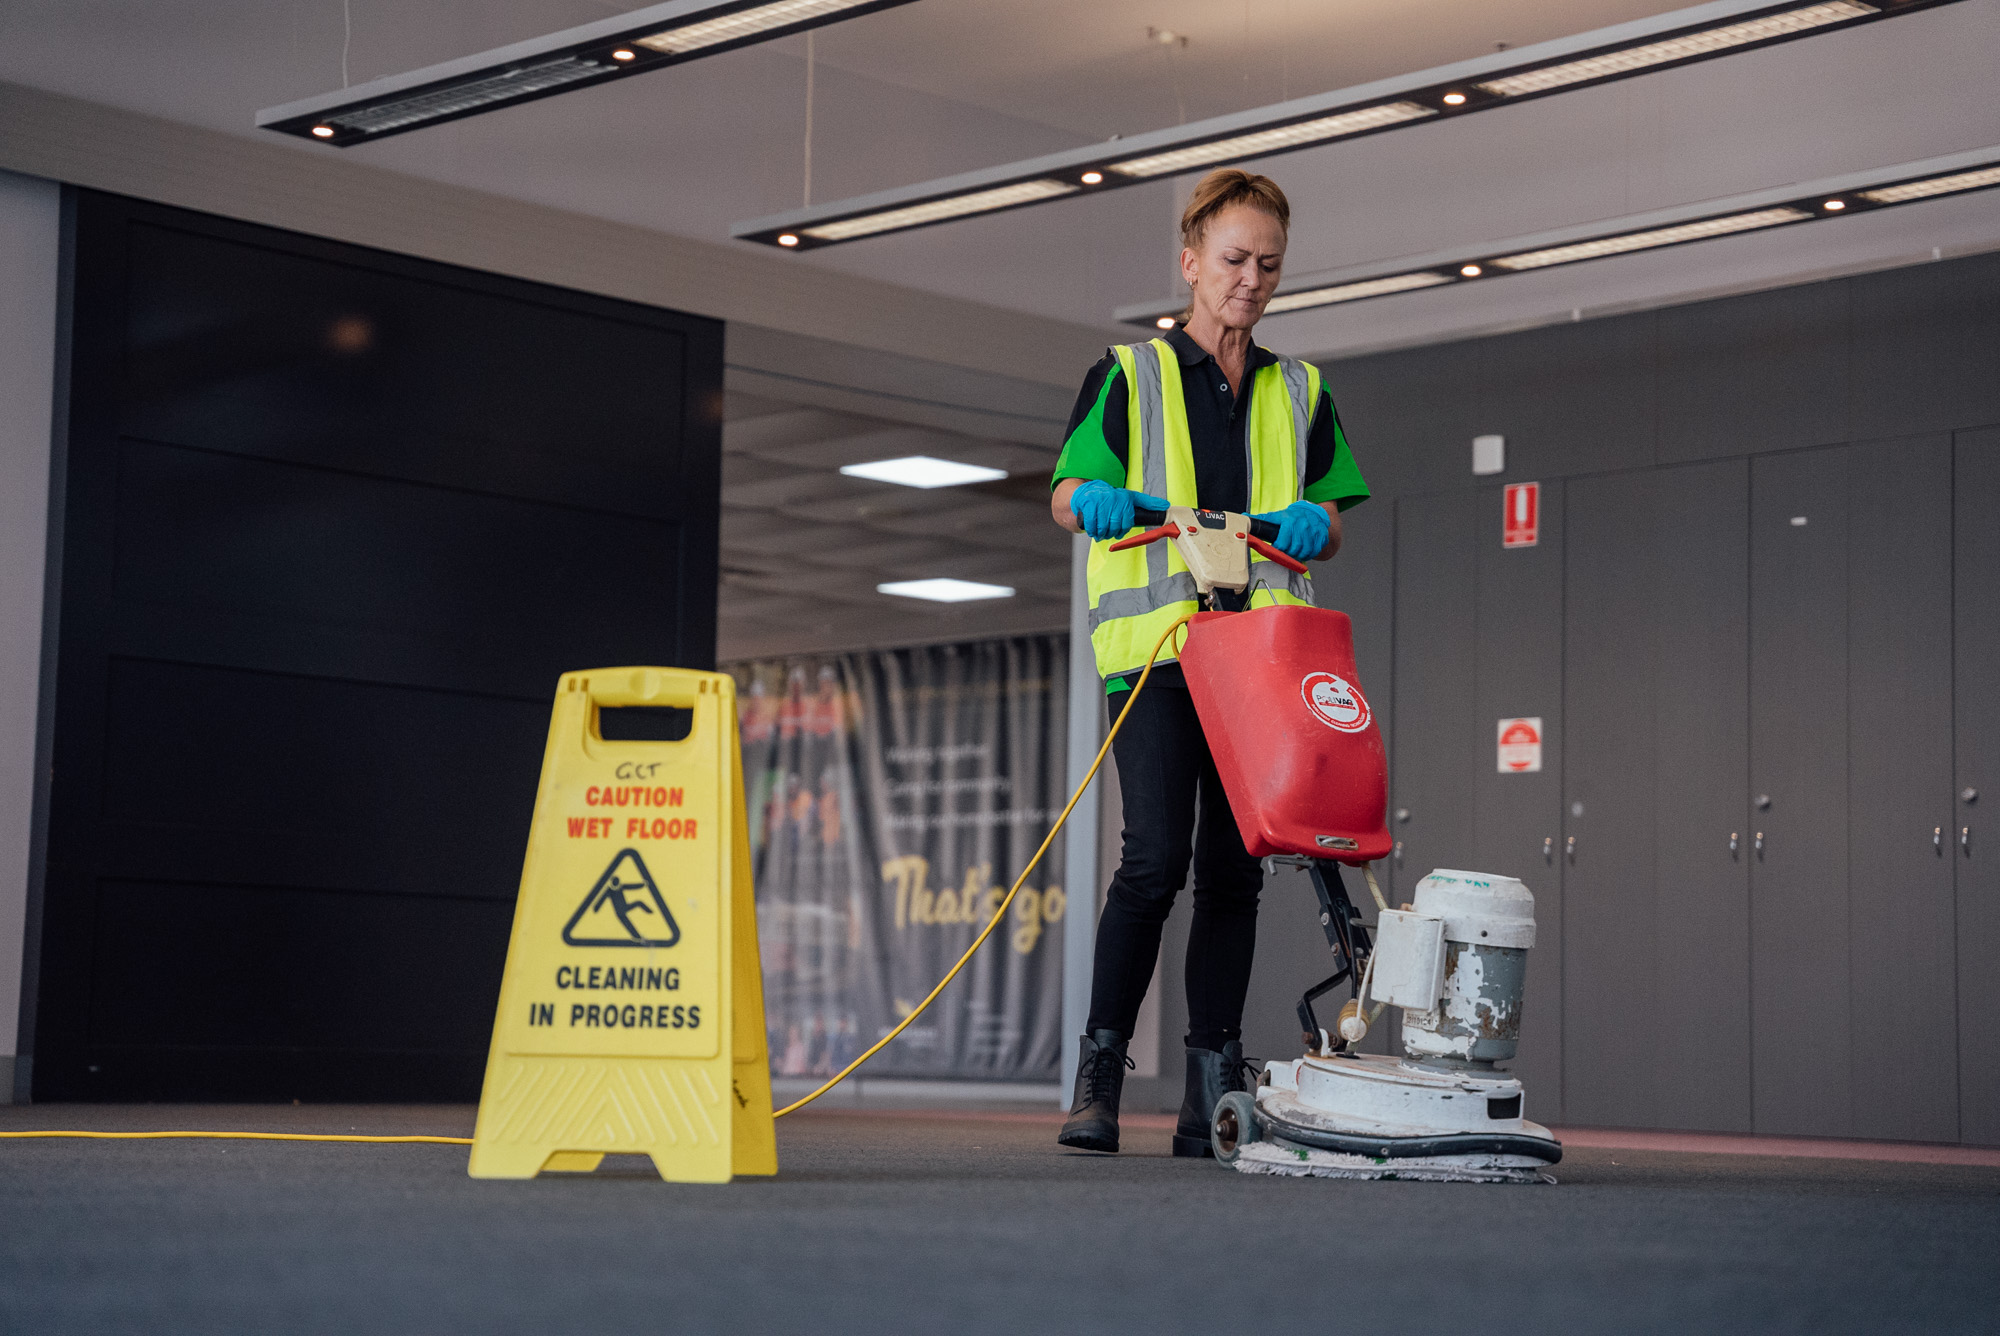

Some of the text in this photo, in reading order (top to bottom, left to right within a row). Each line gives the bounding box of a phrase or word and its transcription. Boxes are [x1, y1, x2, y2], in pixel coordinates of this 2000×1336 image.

[585, 786, 684, 807] CAUTION
[567, 817, 697, 840] WET FLOOR
[556, 966, 680, 990] CLEANING
[529, 1003, 701, 1029] IN PROGRESS
